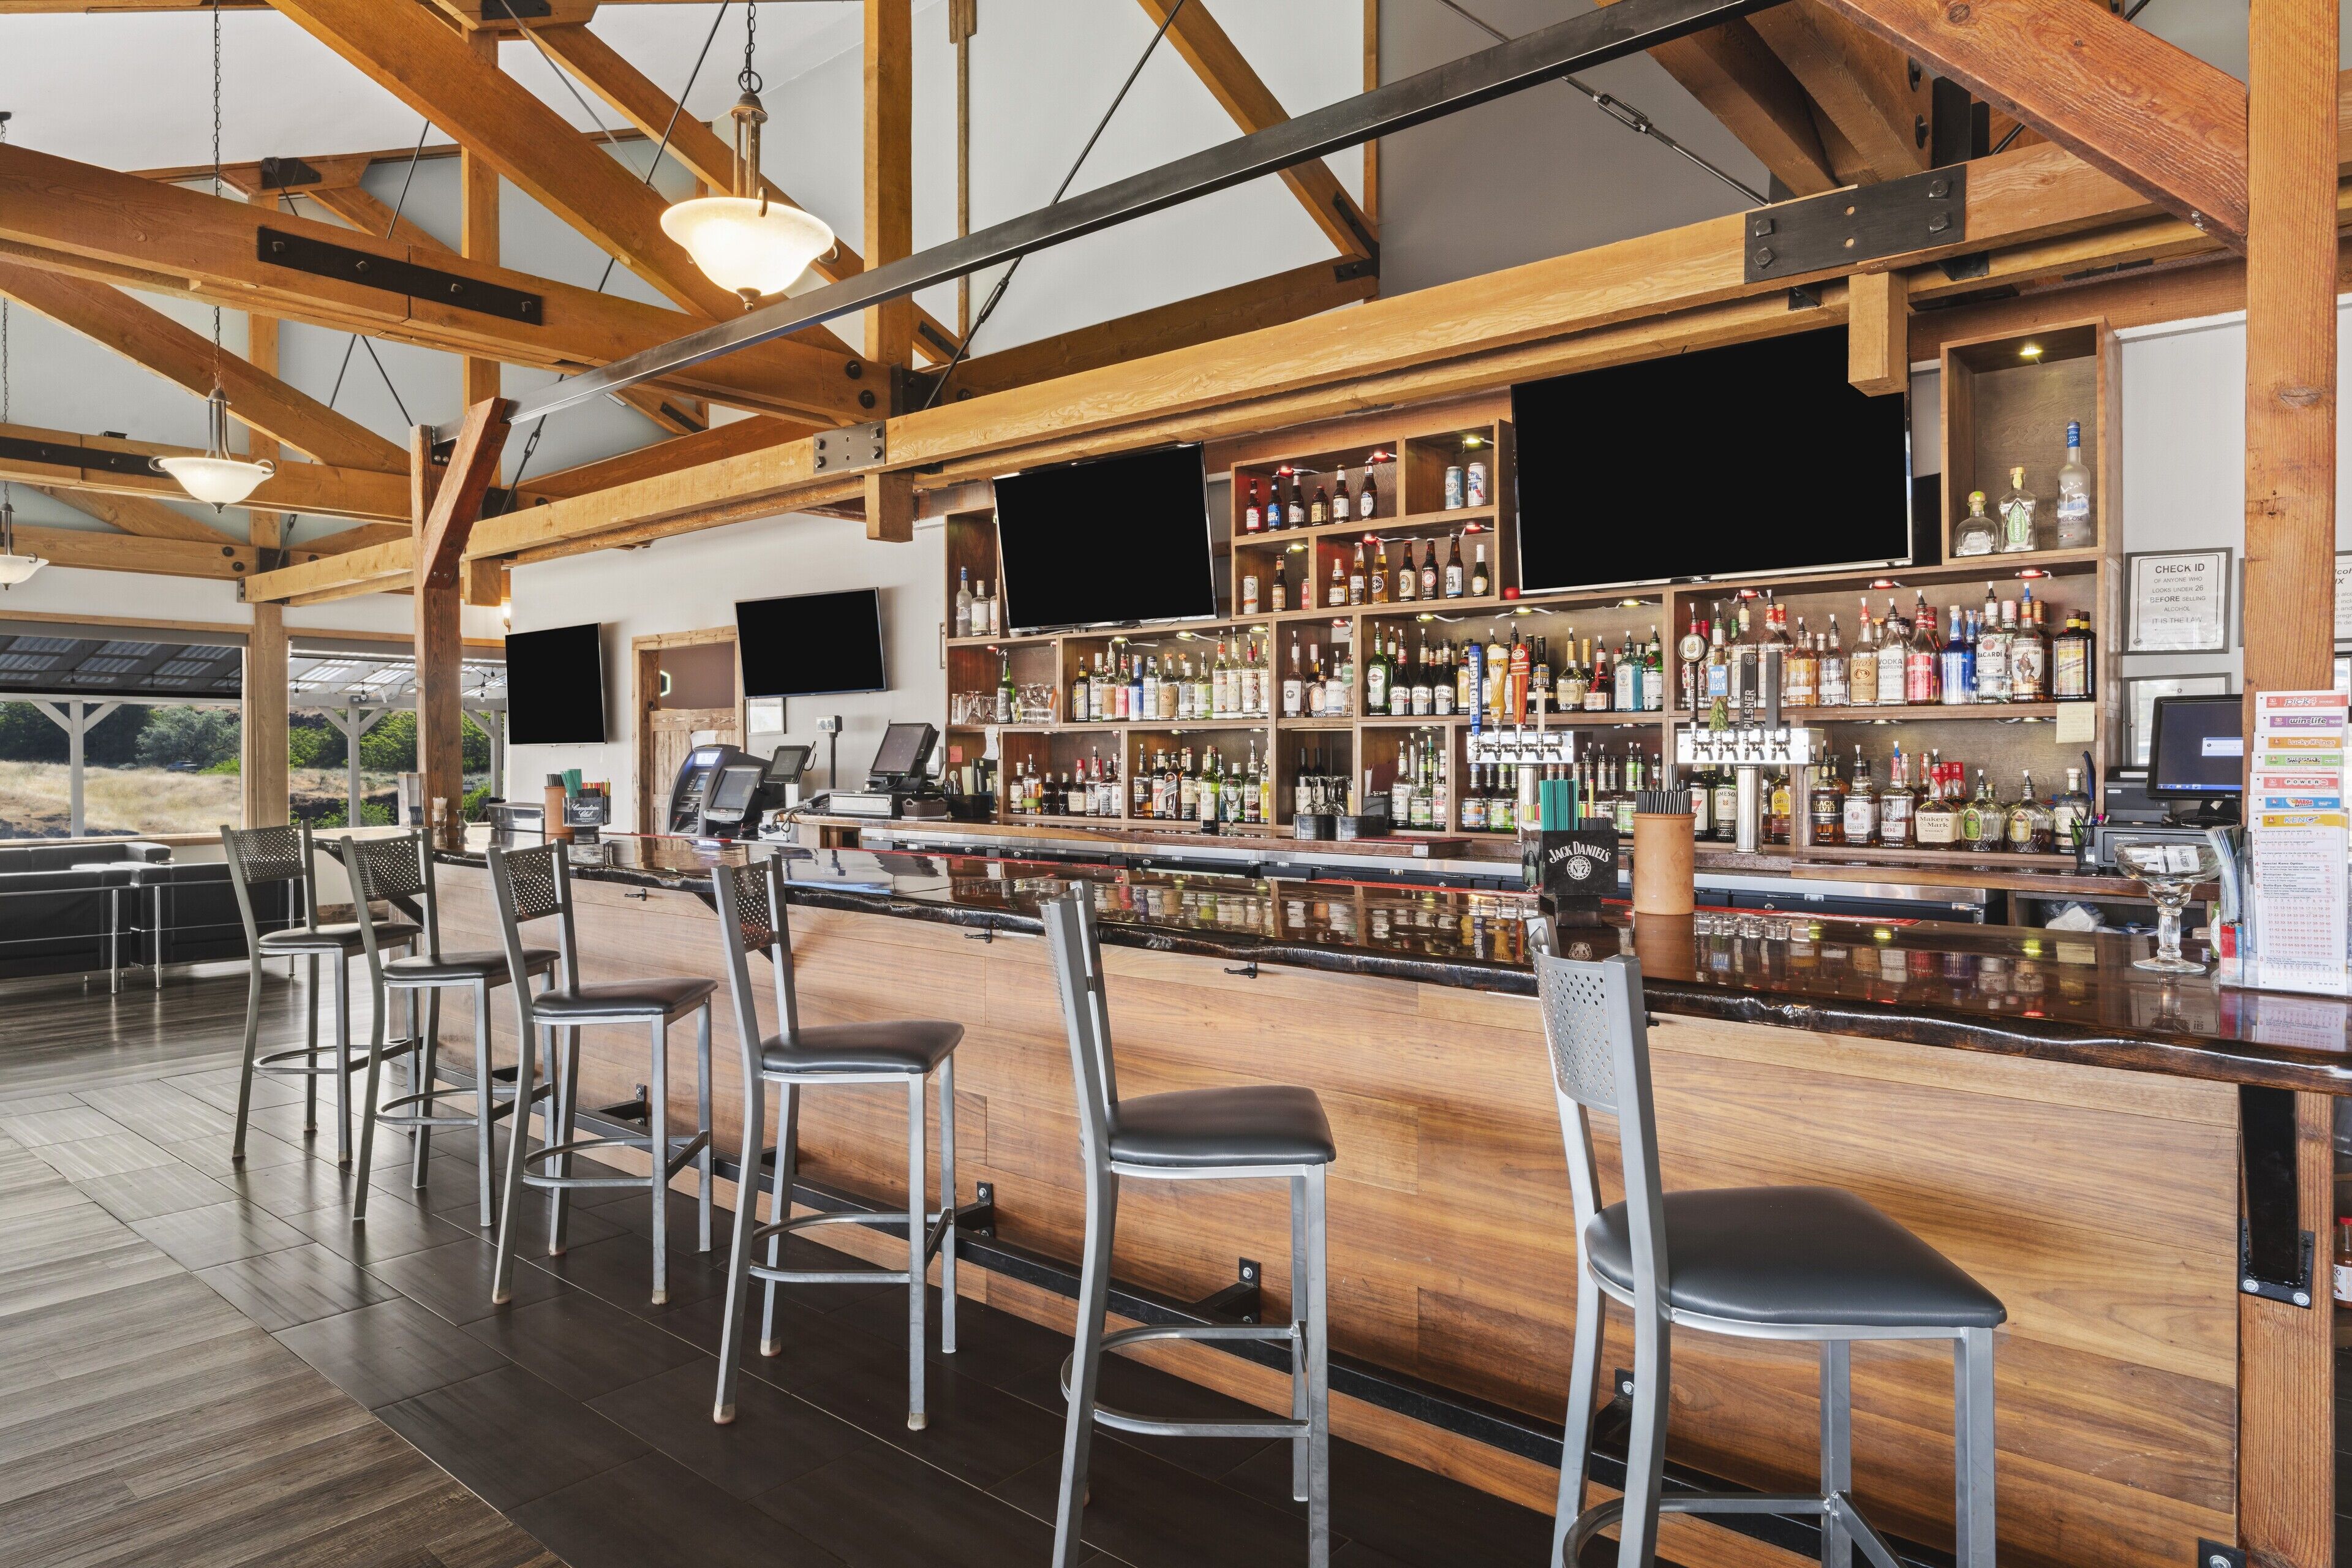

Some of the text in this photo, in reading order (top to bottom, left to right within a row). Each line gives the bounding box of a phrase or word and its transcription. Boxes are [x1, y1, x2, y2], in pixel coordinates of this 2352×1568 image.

[2155, 563, 2205, 573] CHECK ID
[1743, 689, 1754, 729] PILSNER
[1549, 841, 1611, 863] JACK DANIEL'S
